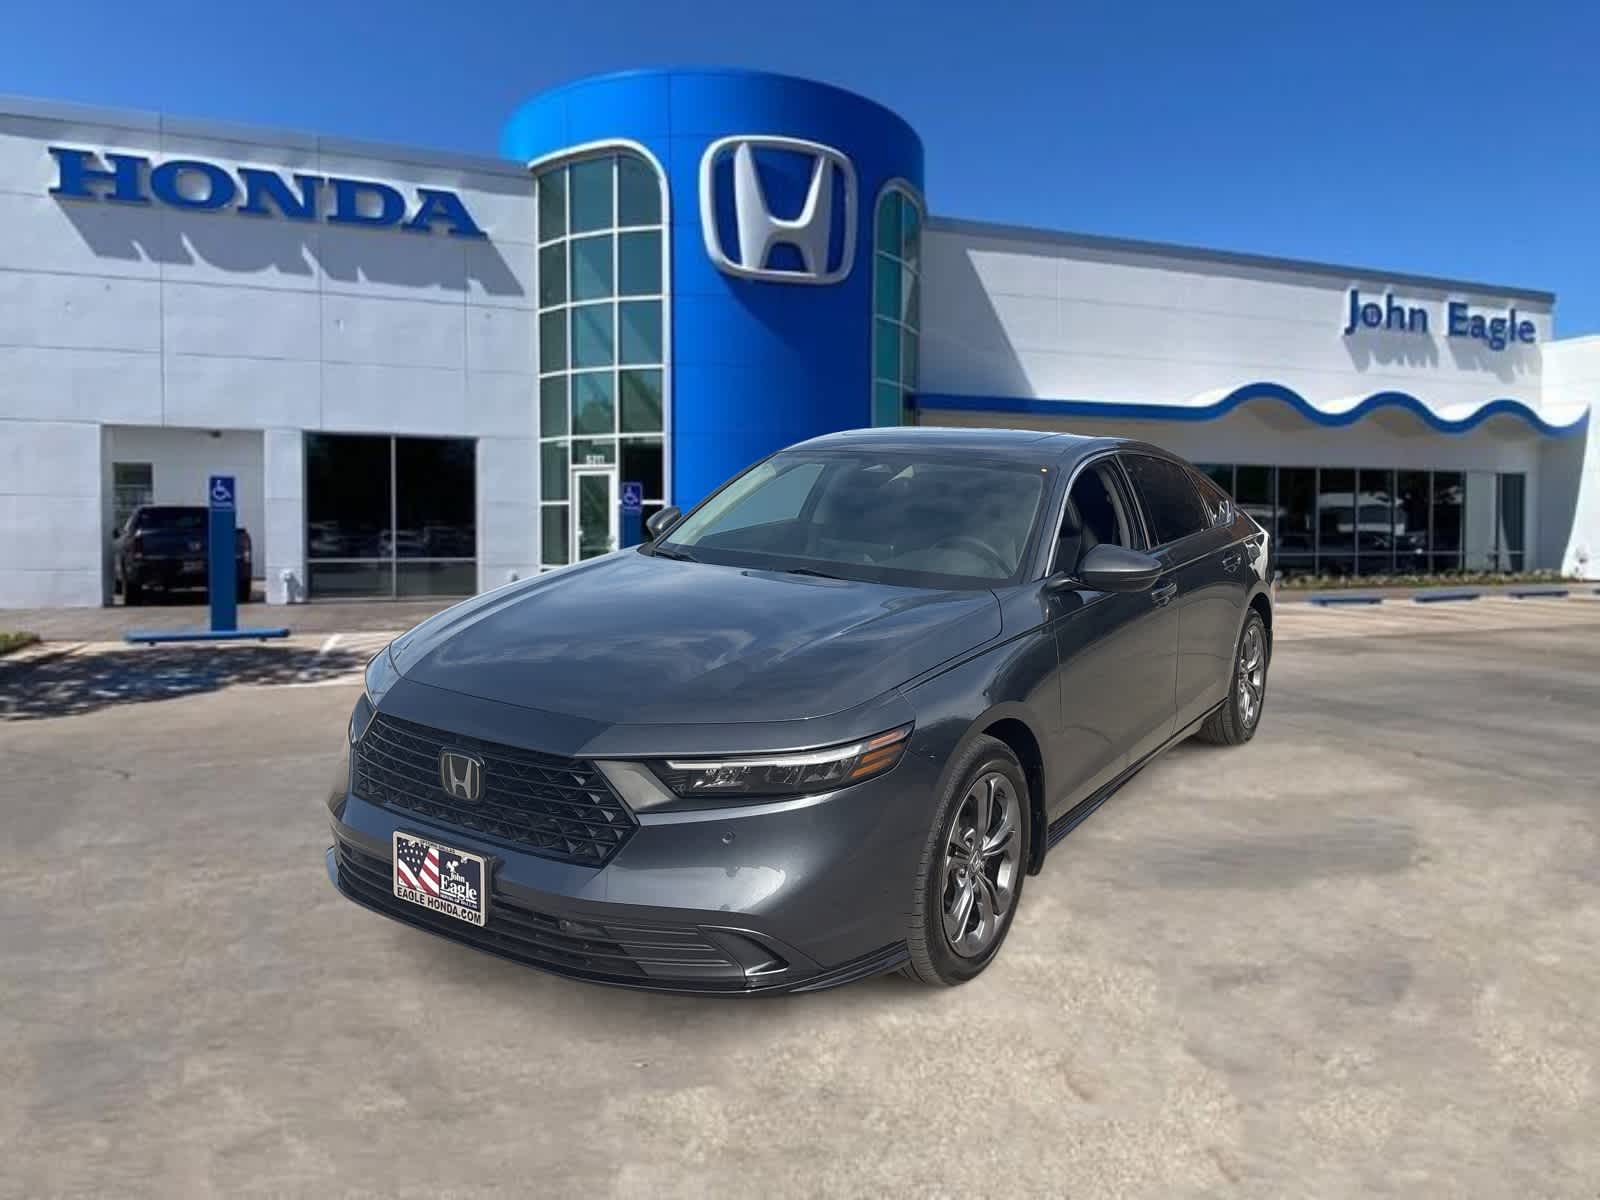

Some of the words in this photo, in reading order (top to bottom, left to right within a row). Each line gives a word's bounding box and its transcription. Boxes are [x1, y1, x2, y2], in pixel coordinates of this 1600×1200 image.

[48, 146, 488, 238] HONDA
[1344, 288, 1429, 337] John
[1447, 301, 1537, 352] Eagle
[440, 874, 477, 901] Eagle
[449, 872, 465, 883] John
[397, 887, 426, 905] EAGLE
[427, 897, 481, 925] HONDA.COM
